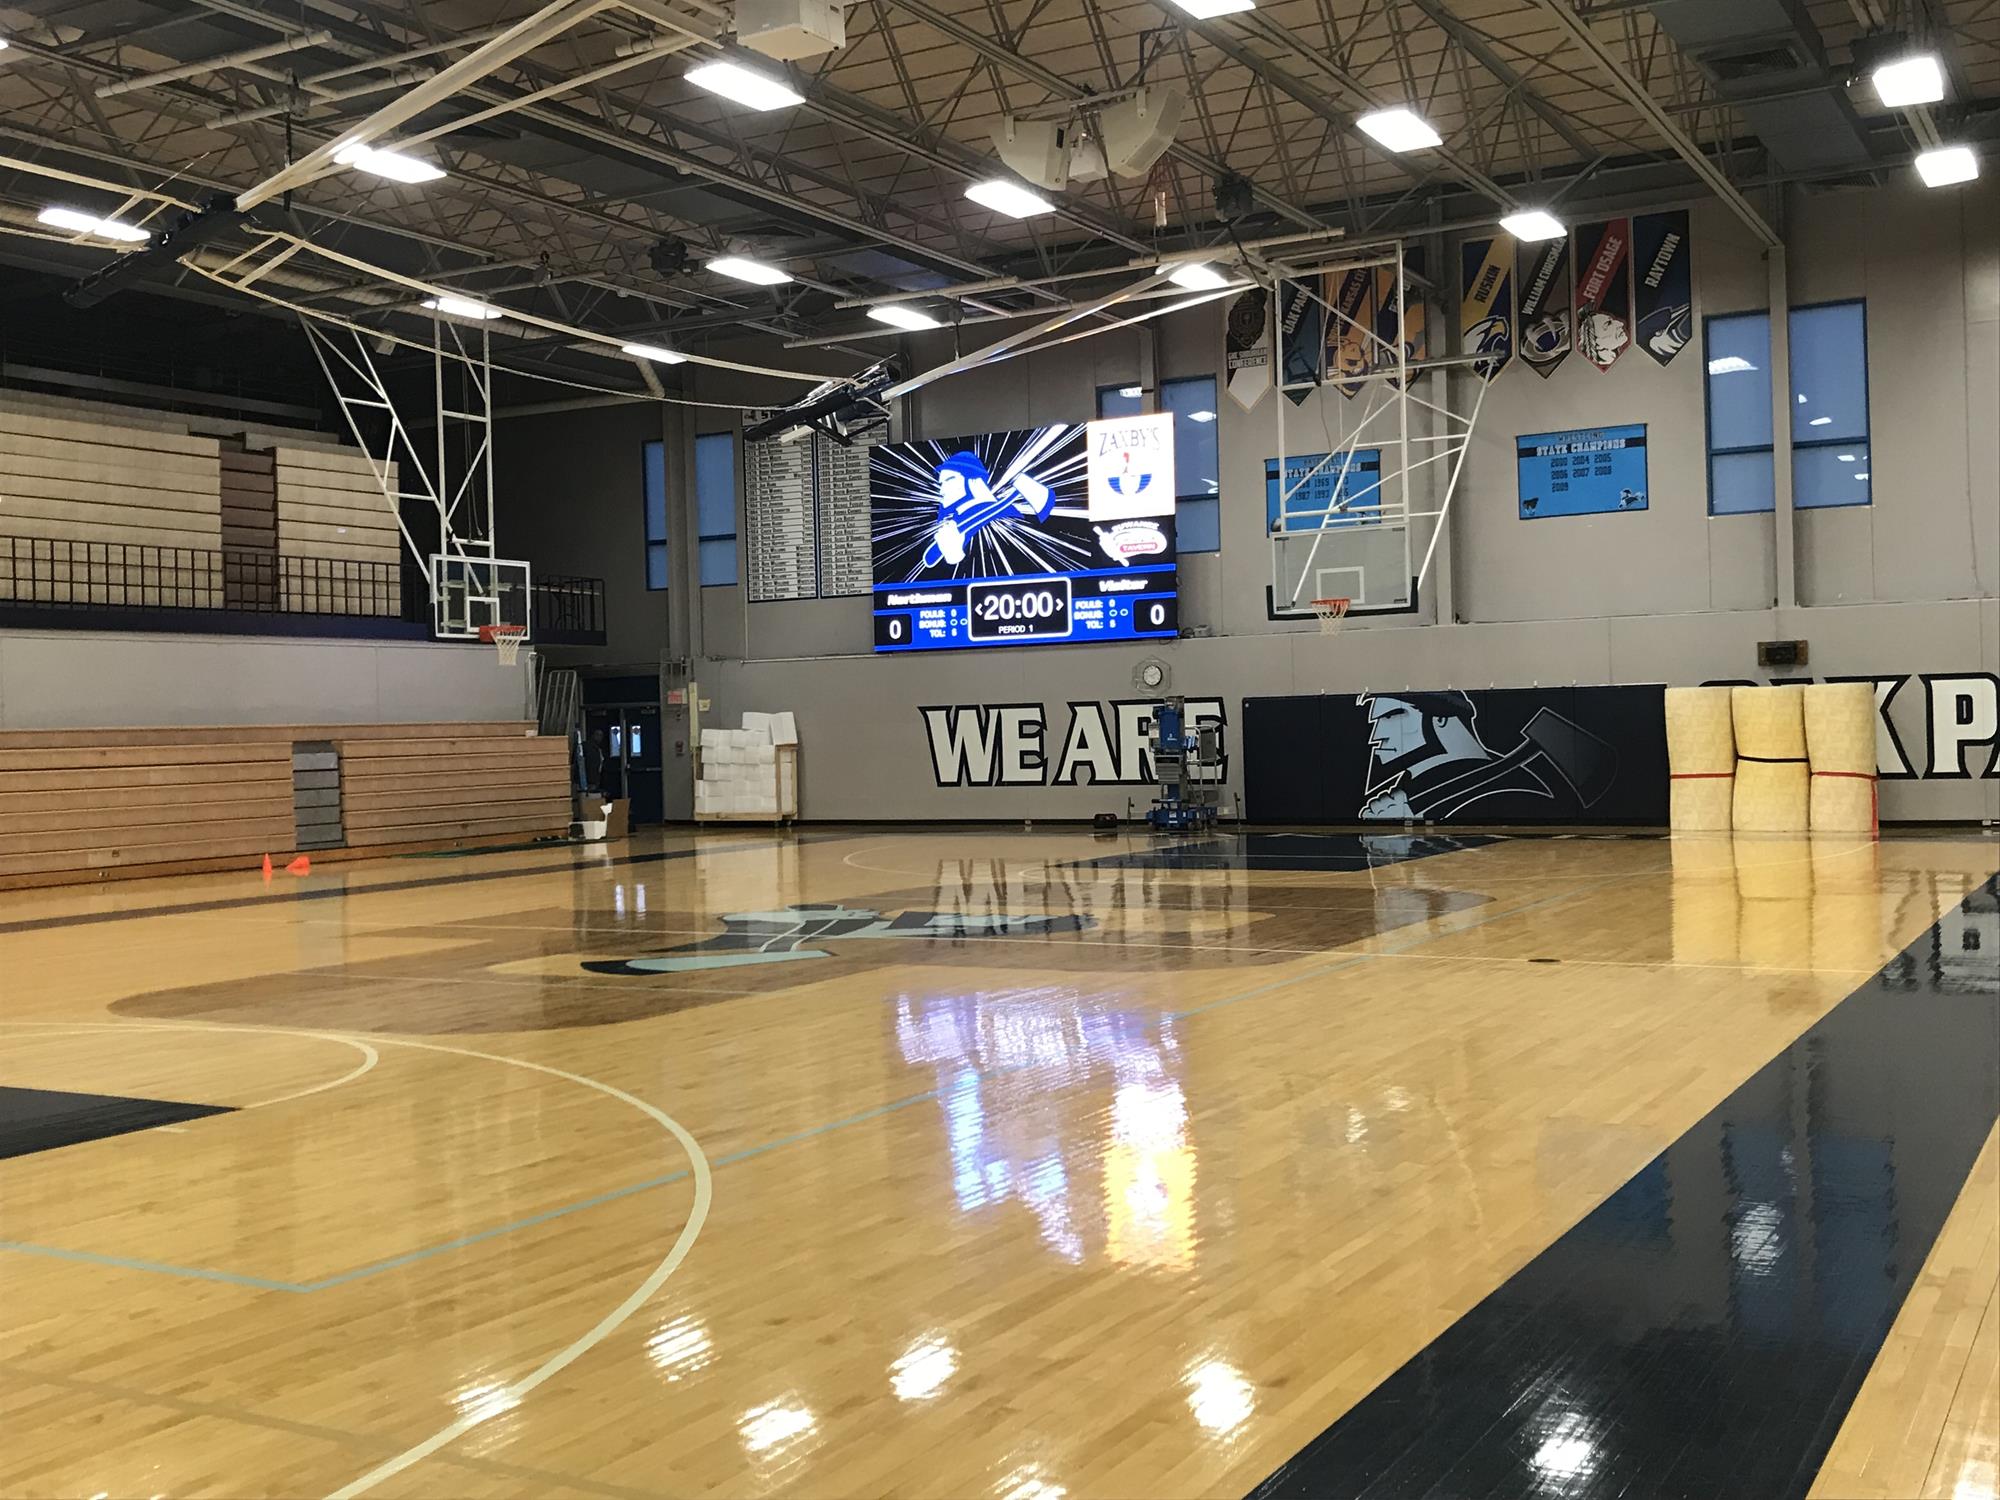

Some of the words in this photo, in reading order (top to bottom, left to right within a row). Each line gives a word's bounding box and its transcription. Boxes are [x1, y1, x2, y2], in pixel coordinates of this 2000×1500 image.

[1583, 270, 1607, 299] FORT
[1596, 236, 1622, 272] OSAGE
[1644, 232, 1681, 288] RAYTOWN
[1474, 264, 1501, 303] RUSKIN
[1521, 278, 1548, 315] WILLIAM
[1282, 310, 1302, 334] OAK
[1228, 355, 1267, 369] CONFERENCE
[1536, 443, 1569, 456] STATE
[1570, 438, 1626, 453] CHAMPIONS
[984, 591, 1053, 620] 20:00
[1150, 604, 1165, 625] 0
[889, 619, 902, 640] 0
[998, 625, 1026, 633] PERIOD
[1028, 624, 1034, 632] 1
[917, 702, 1048, 787] WE
